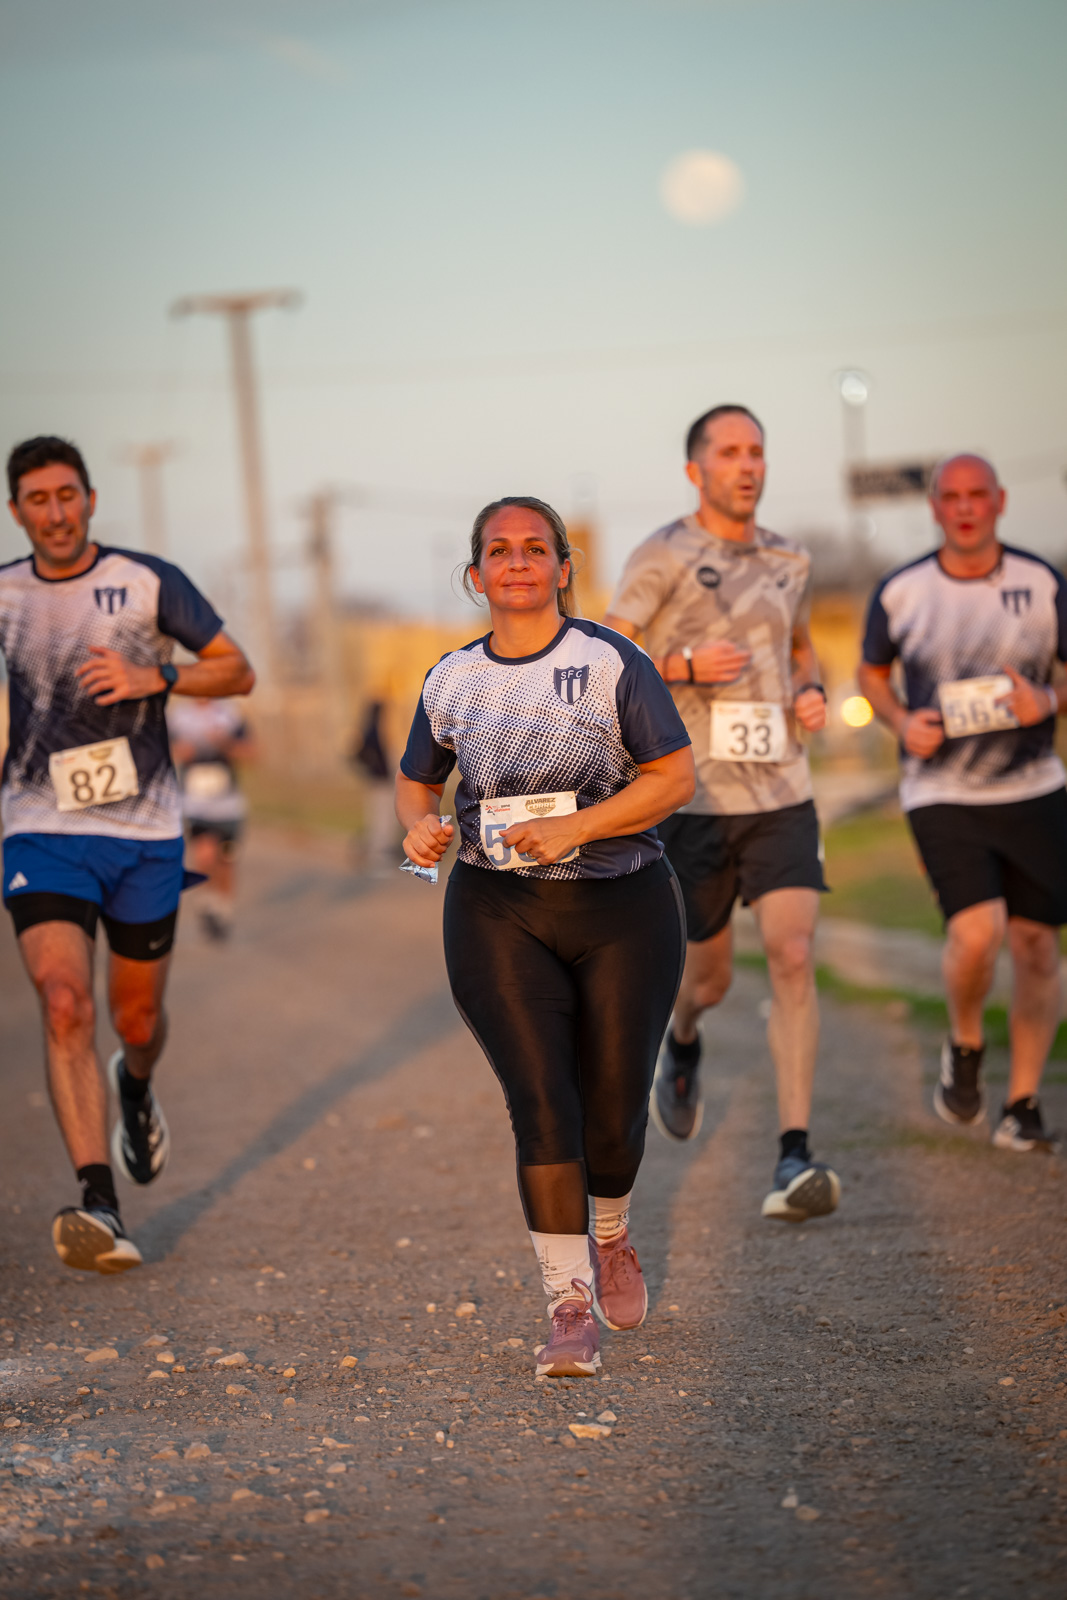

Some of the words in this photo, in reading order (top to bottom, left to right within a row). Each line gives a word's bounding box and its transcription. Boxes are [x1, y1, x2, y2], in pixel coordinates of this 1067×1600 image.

[560, 669, 583, 680] SFC
[729, 723, 771, 756] 33
[70, 764, 121, 803] 82
[525, 797, 556, 806] ALVAREZ
